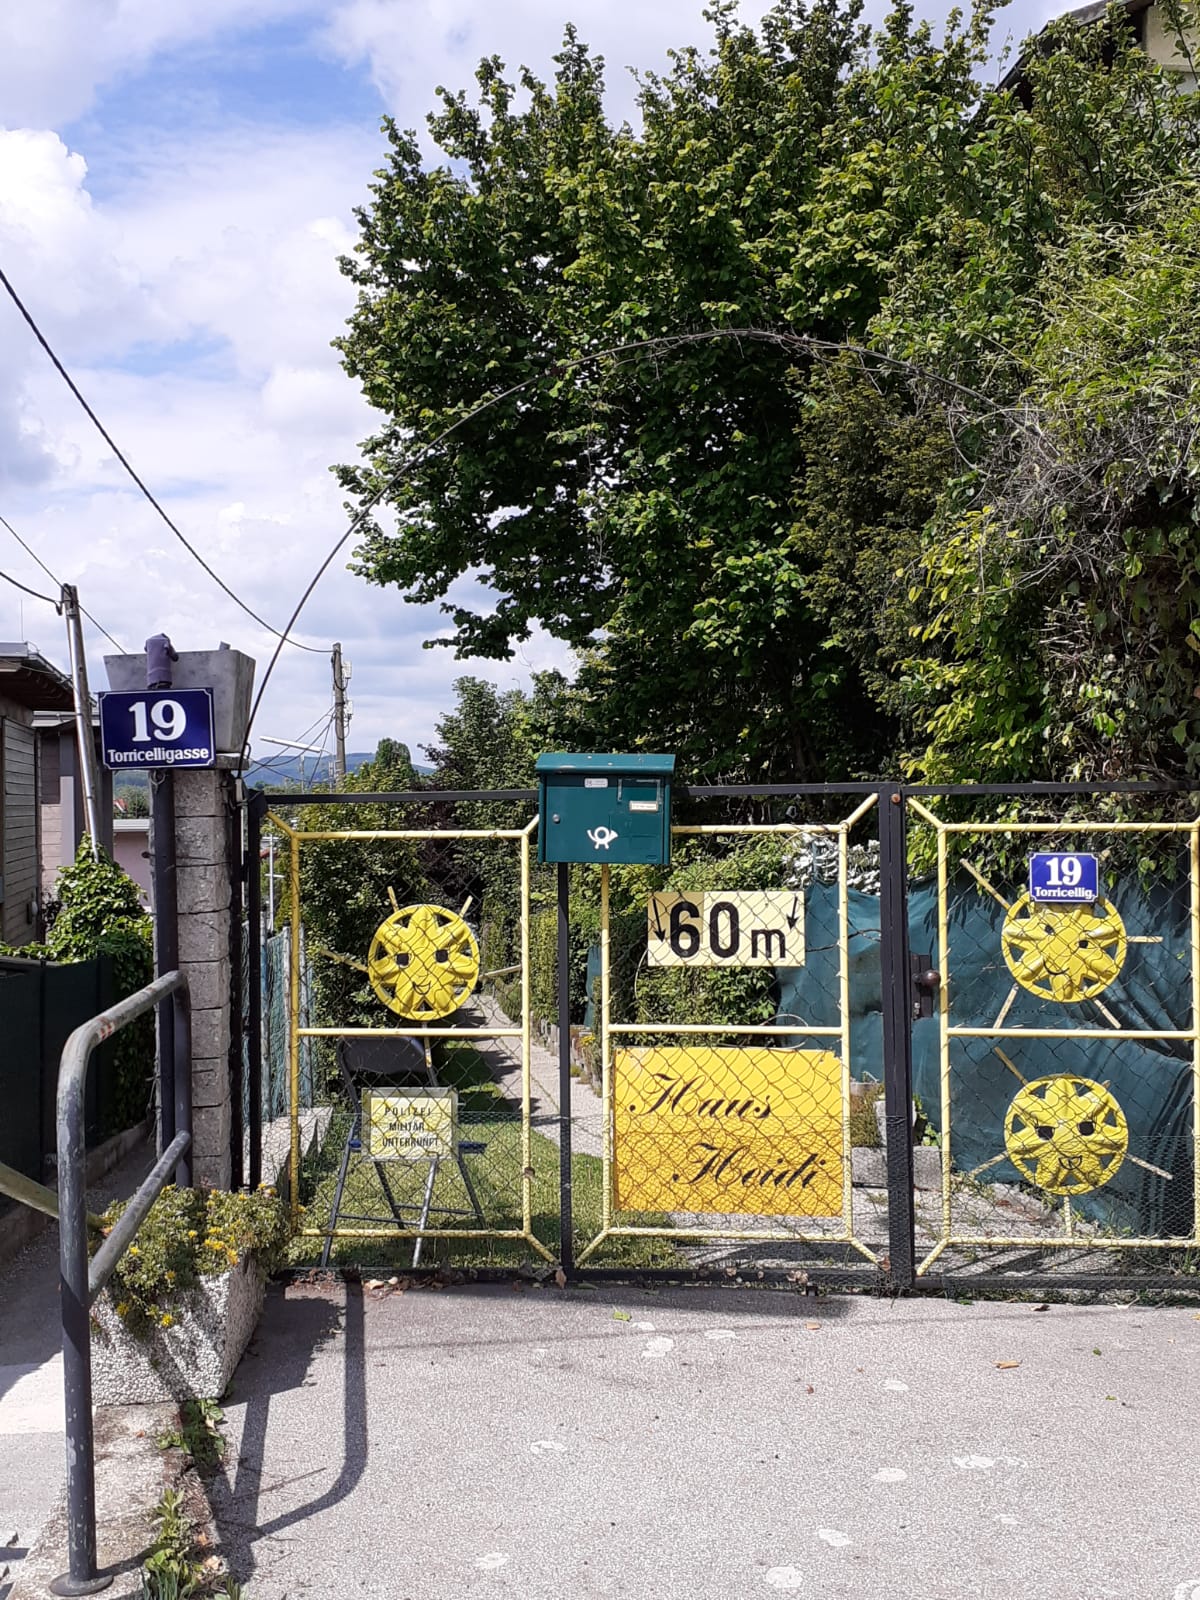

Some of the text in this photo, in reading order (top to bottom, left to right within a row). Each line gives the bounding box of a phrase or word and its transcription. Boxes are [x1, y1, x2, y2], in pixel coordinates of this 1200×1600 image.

[128, 699, 187, 742] 19
[107, 747, 209, 764] Torricelligasse
[1046, 857, 1082, 886] 19
[629, 1072, 771, 1119] Haus
[672, 1142, 827, 1189] Heidi
